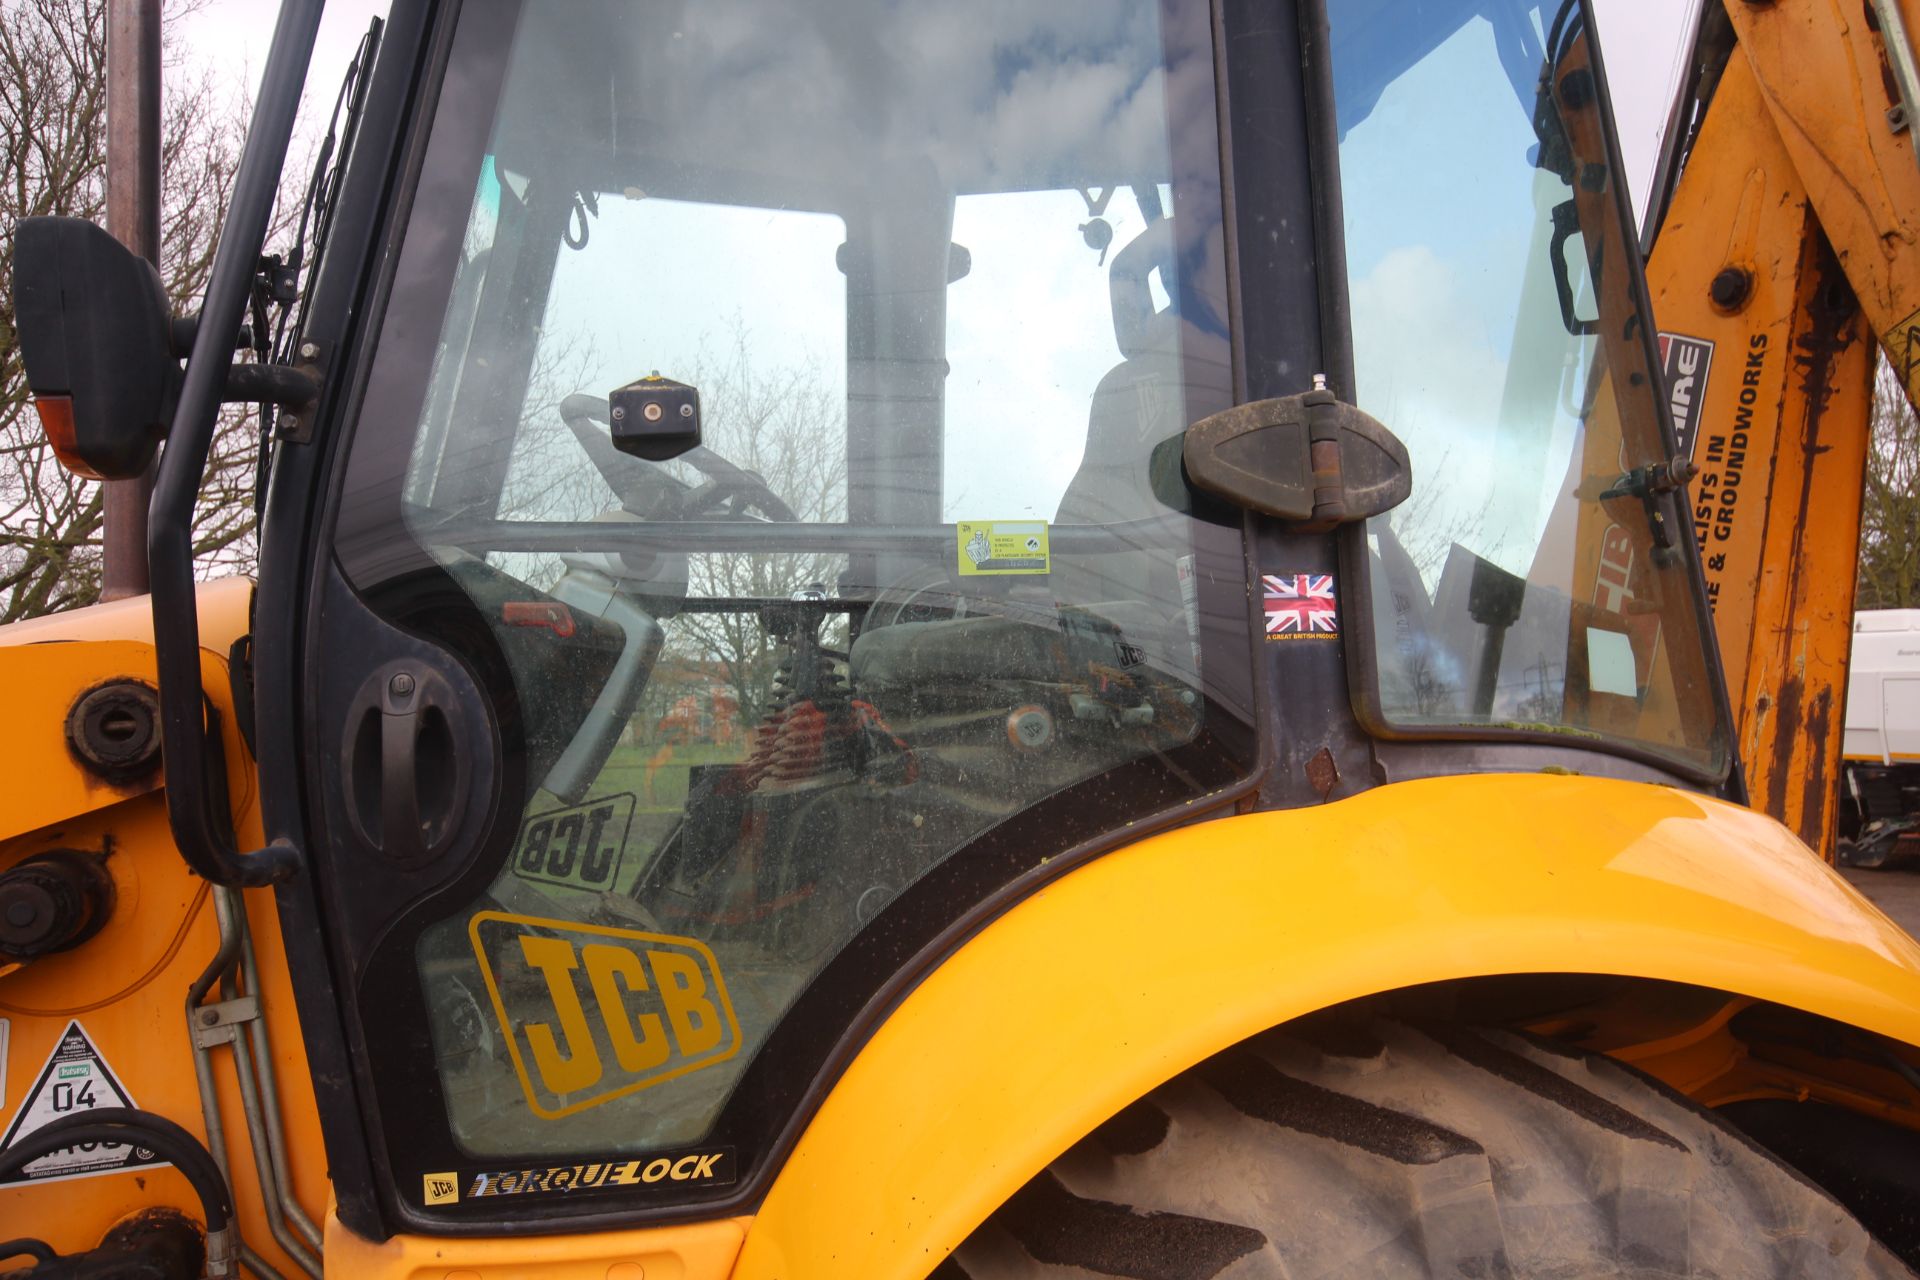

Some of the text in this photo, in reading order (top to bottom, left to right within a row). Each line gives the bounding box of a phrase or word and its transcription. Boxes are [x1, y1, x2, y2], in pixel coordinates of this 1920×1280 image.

[1706, 435, 1725, 463] IN
[1714, 333, 1768, 542] GROUNDWORKS
[1708, 552, 1726, 572] &
[1272, 633, 1292, 641] GREAT
[1120, 646, 1144, 666] JCB
[519, 935, 723, 1095] JCB
[53, 1079, 96, 1112] 04
[432, 1153, 723, 1197] JCB TORQUELOCK
